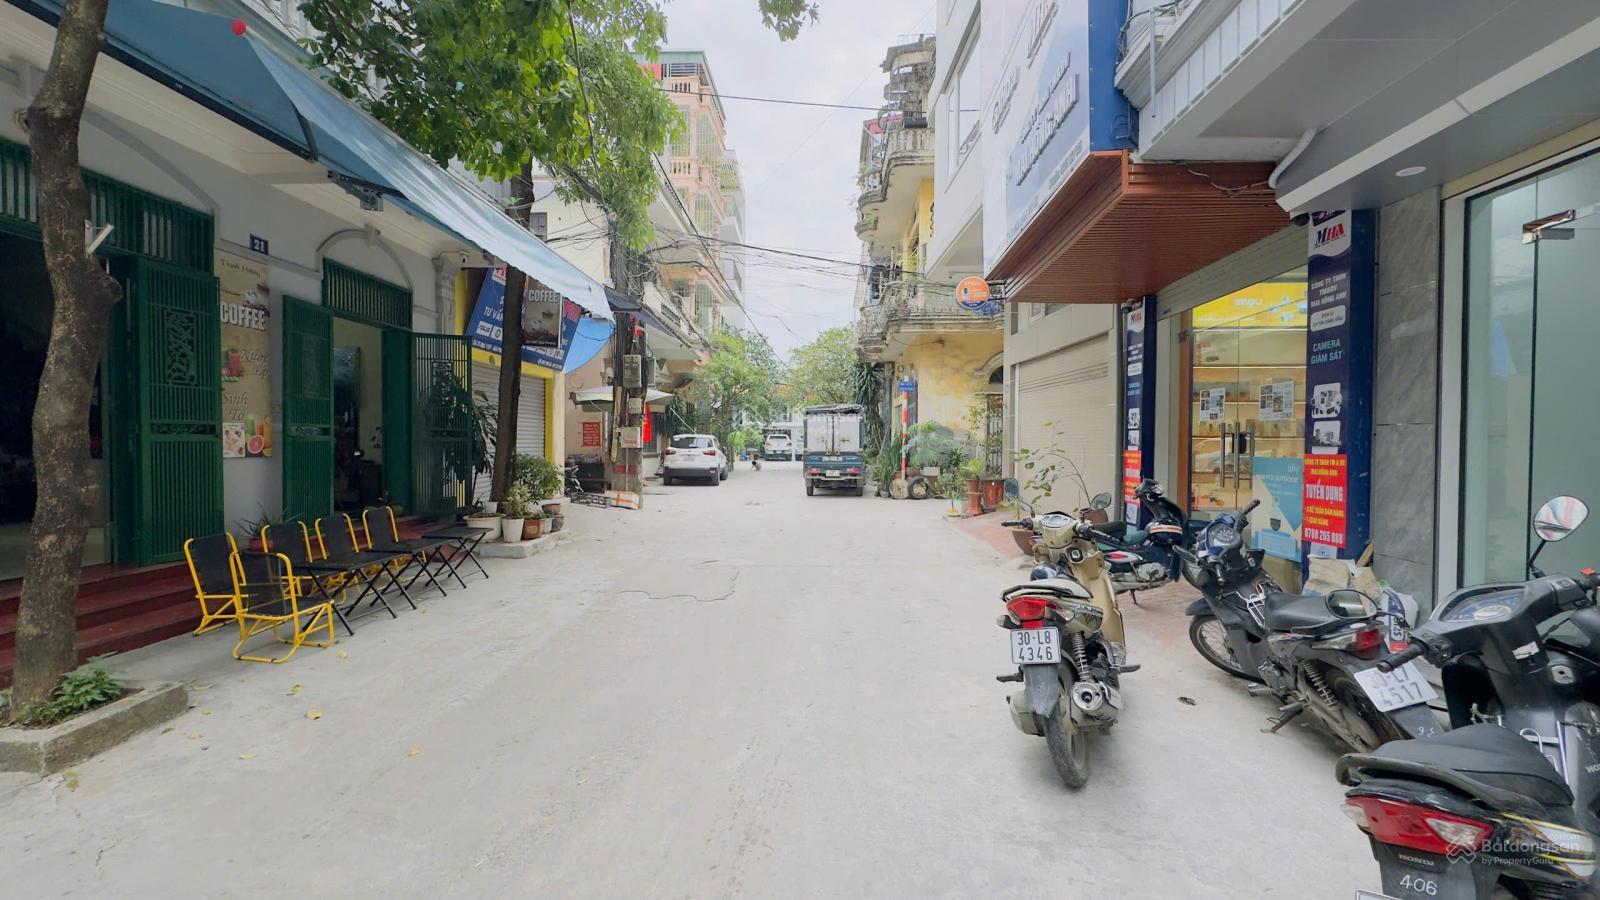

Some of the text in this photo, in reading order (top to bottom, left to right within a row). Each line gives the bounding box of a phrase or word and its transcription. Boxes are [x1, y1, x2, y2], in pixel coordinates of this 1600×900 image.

[254, 239, 265, 253] 21
[529, 289, 559, 303] COFFEE
[220, 301, 266, 331] COFFEE
[1312, 339, 1341, 352] CAMERA
[1311, 349, 1343, 364] GIÁM SÁT
[1017, 630, 1051, 645] 30-L8
[1019, 646, 1052, 661] 4346
[1398, 854, 1435, 867] HONDA
[1399, 874, 1438, 896] 406
